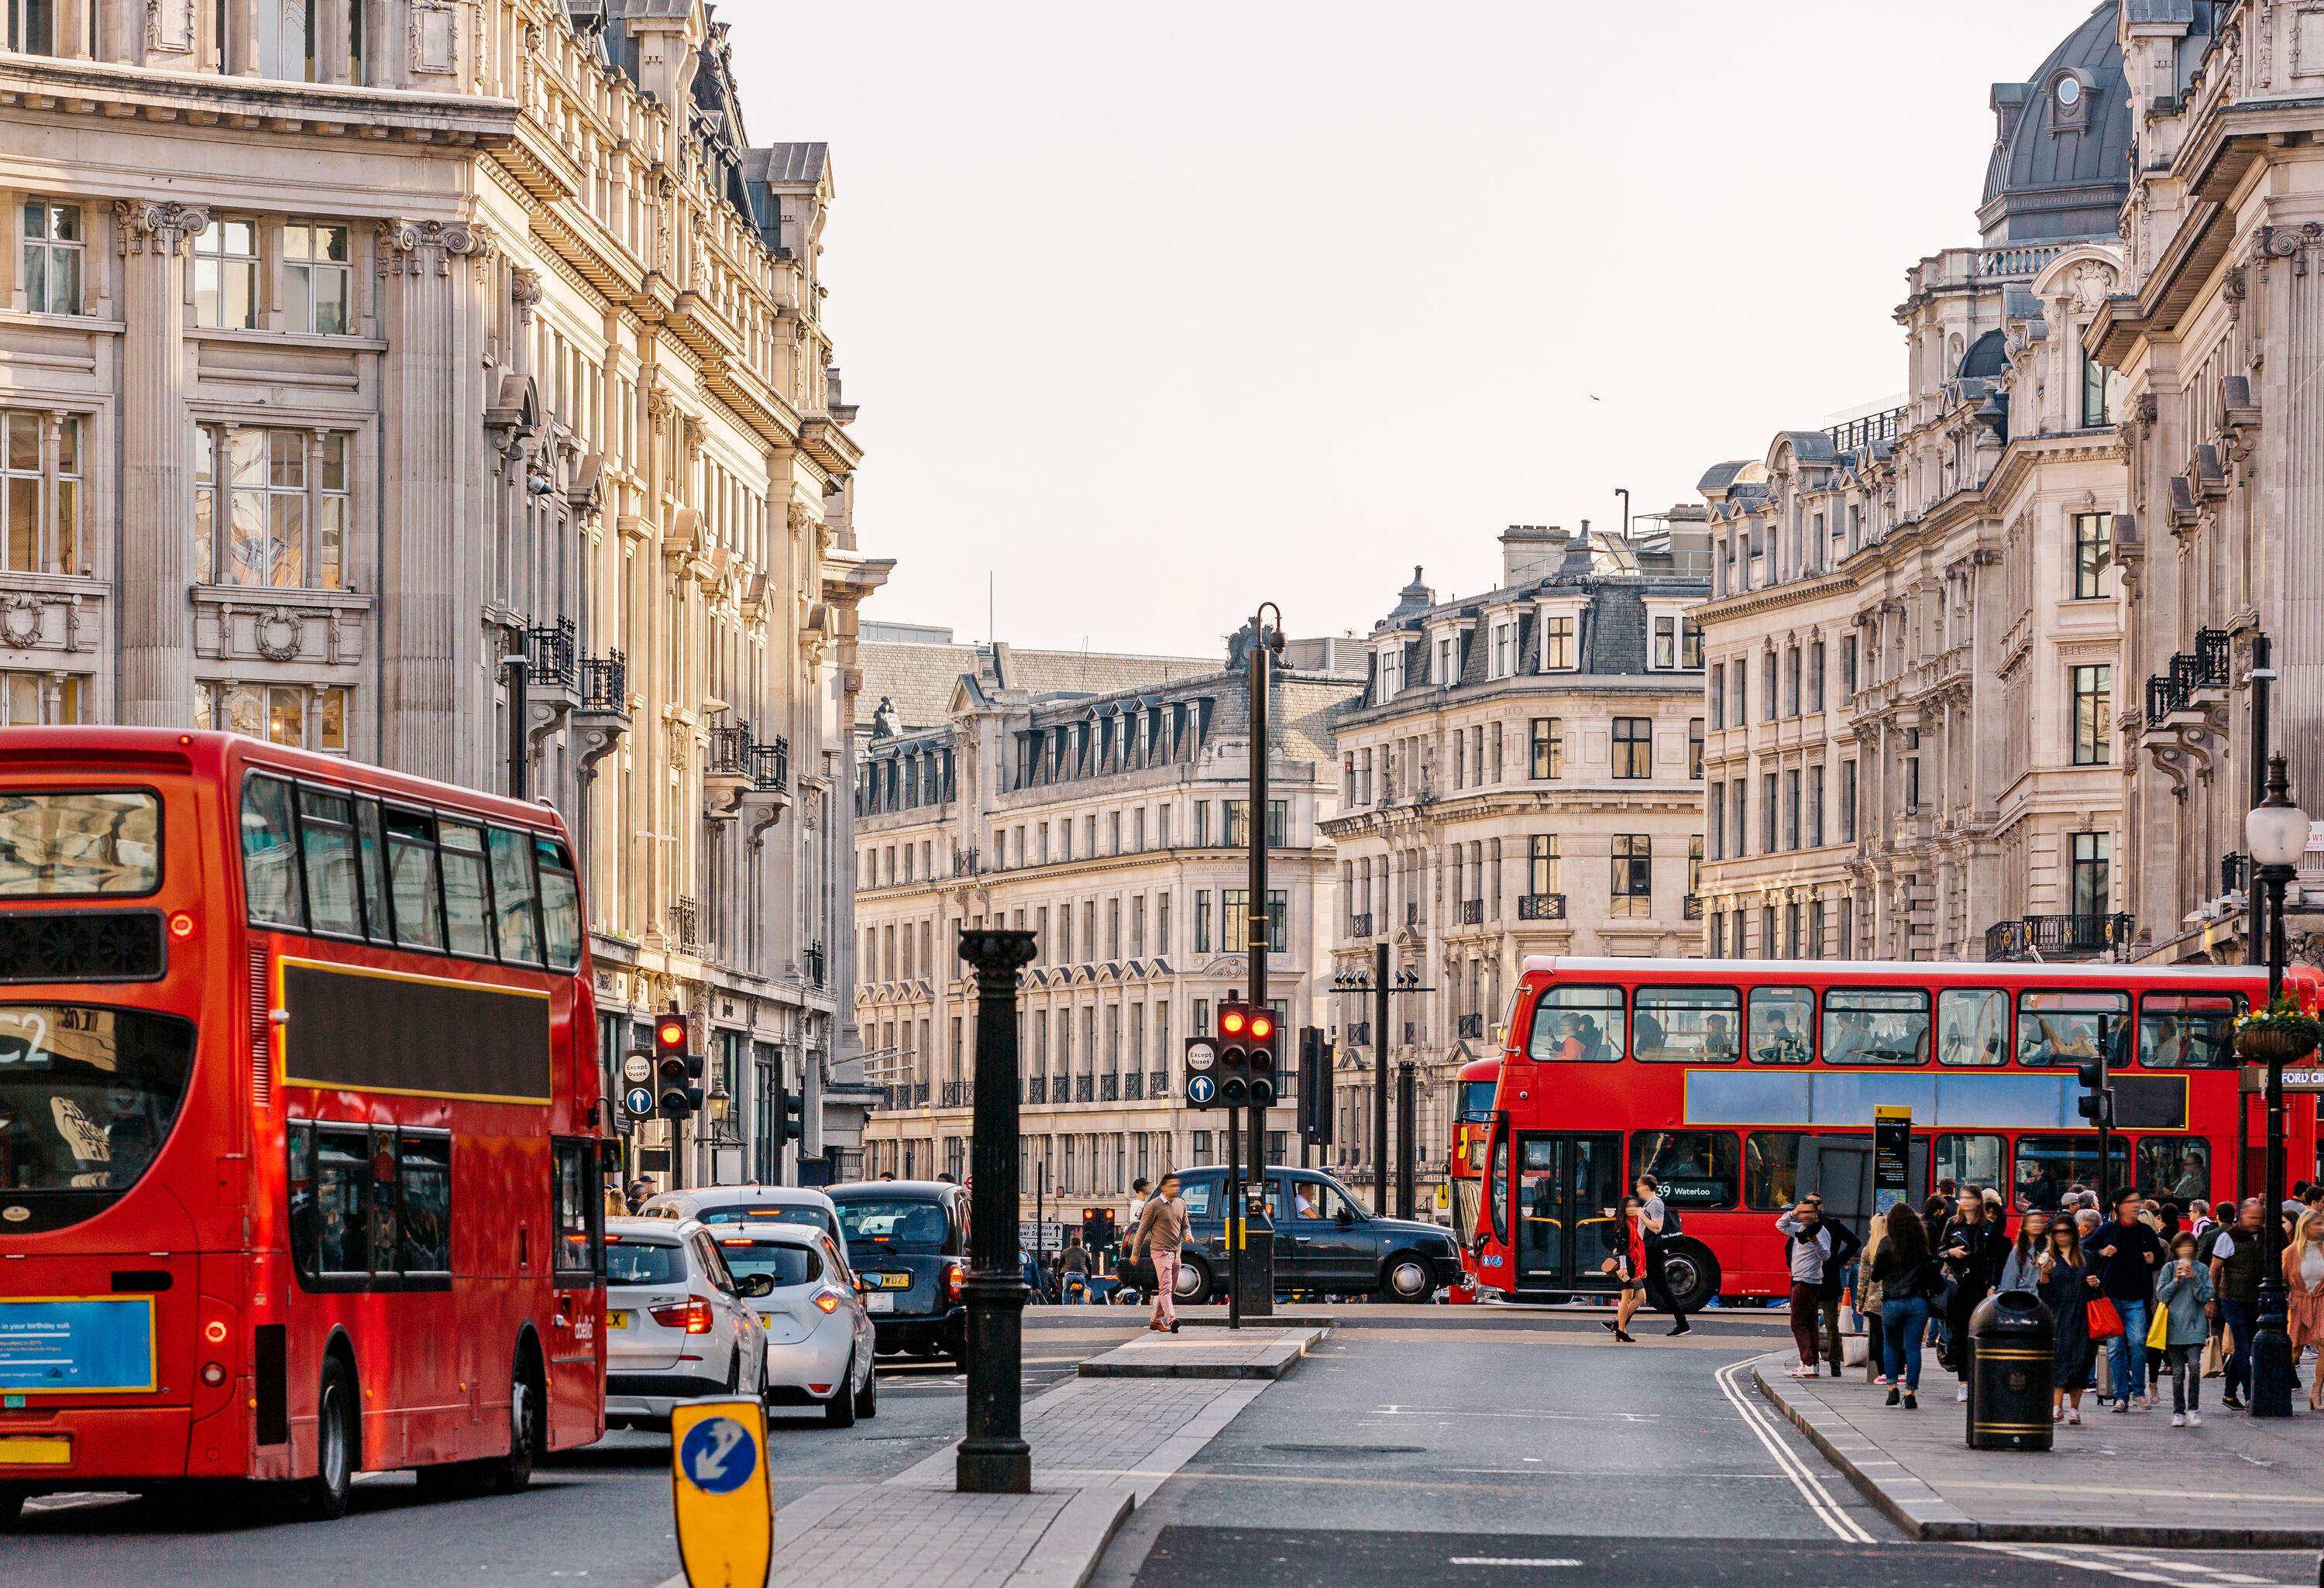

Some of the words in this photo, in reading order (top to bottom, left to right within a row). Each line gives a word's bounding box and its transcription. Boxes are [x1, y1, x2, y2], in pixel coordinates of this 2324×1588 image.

[2281, 1072, 2309, 1084] FORD
[1655, 1185, 1671, 1197] 39
[1674, 1187, 1710, 1195] Waterloo
